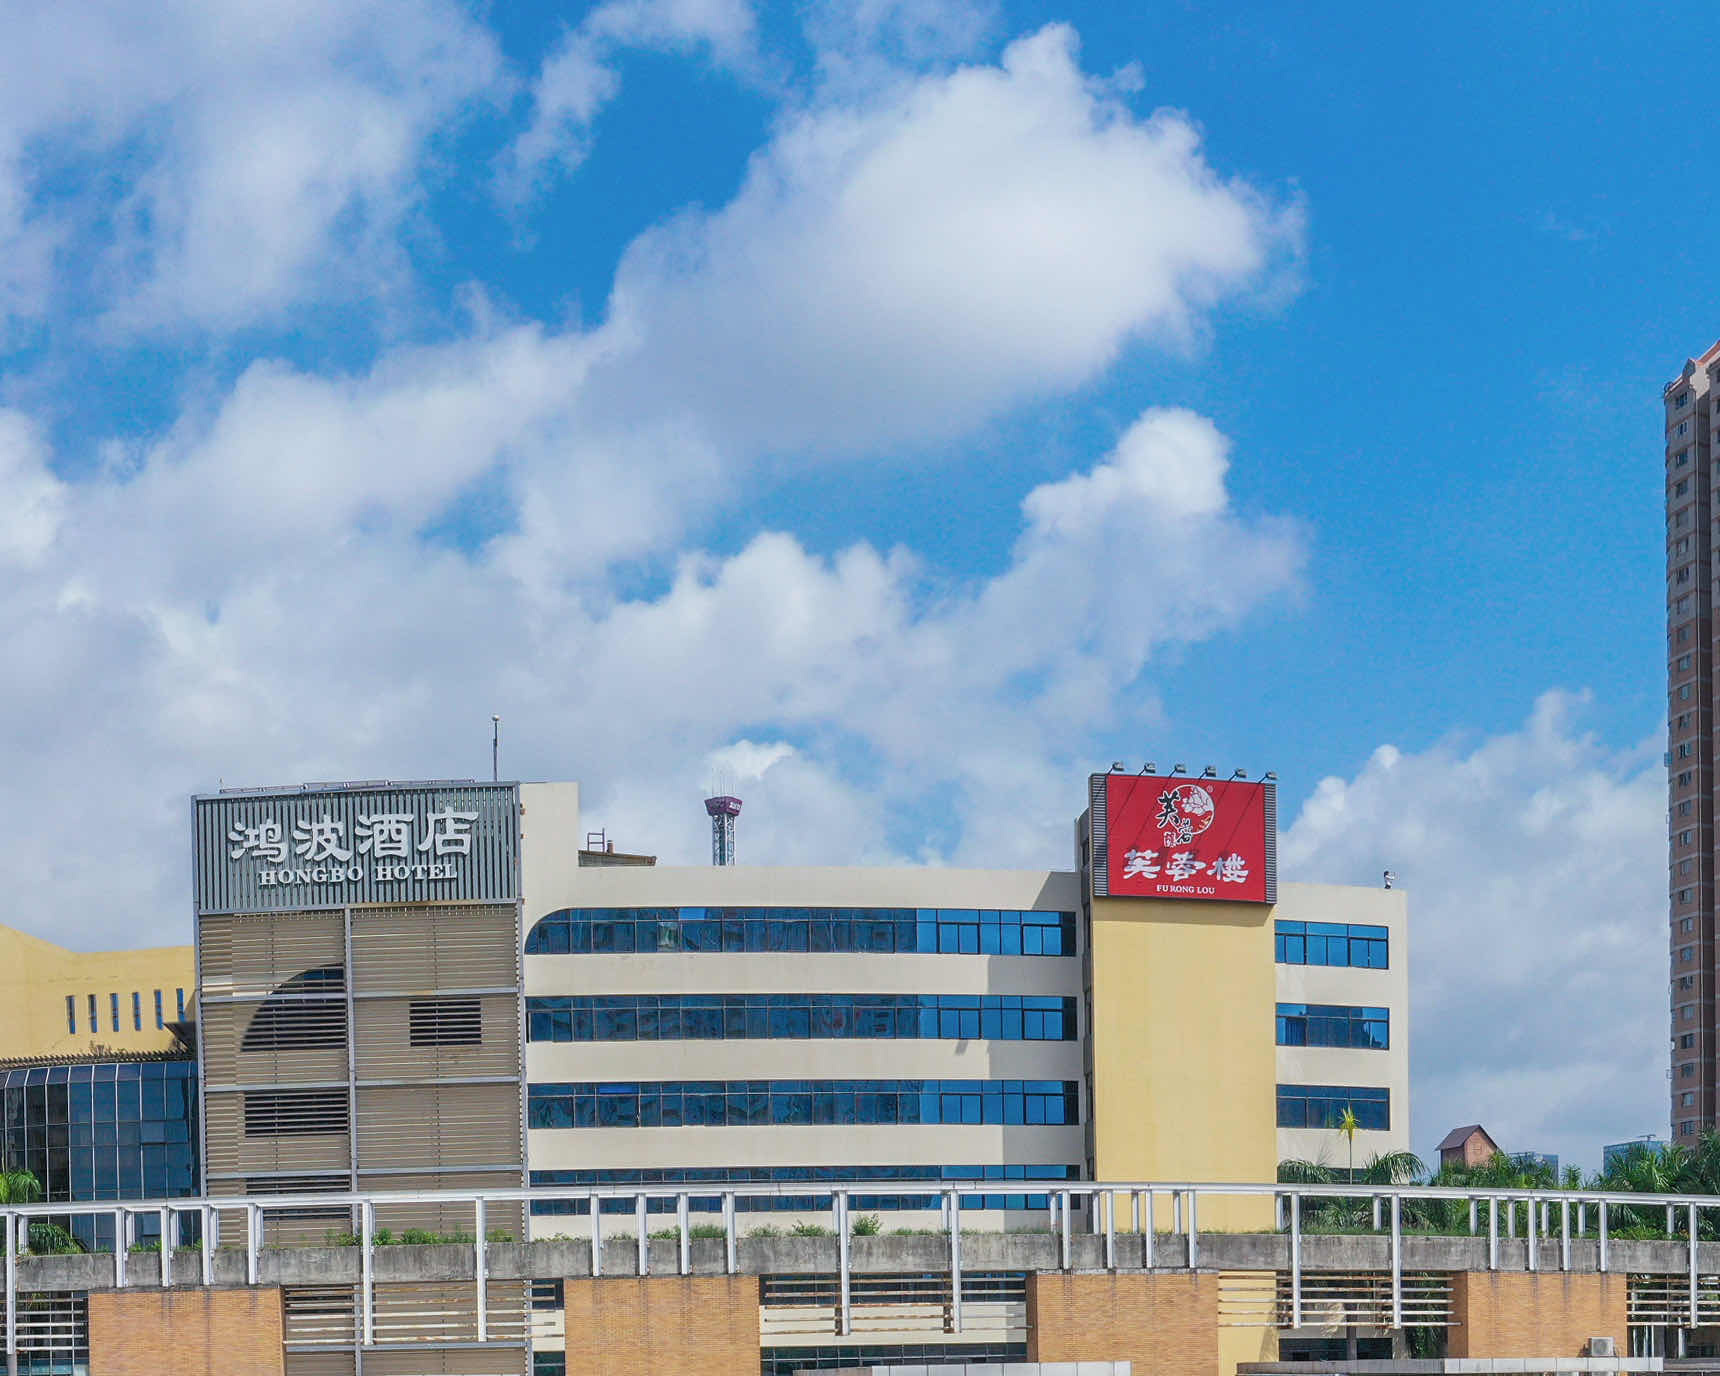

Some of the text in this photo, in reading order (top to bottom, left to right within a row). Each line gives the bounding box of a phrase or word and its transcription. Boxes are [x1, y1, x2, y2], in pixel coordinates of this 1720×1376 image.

[228, 806, 480, 863] 鸿波酒店
[259, 863, 458, 886] HONGBO HOTEL
[1122, 849, 1249, 884] 芙蓉楼
[1196, 886, 1216, 895] LOU
